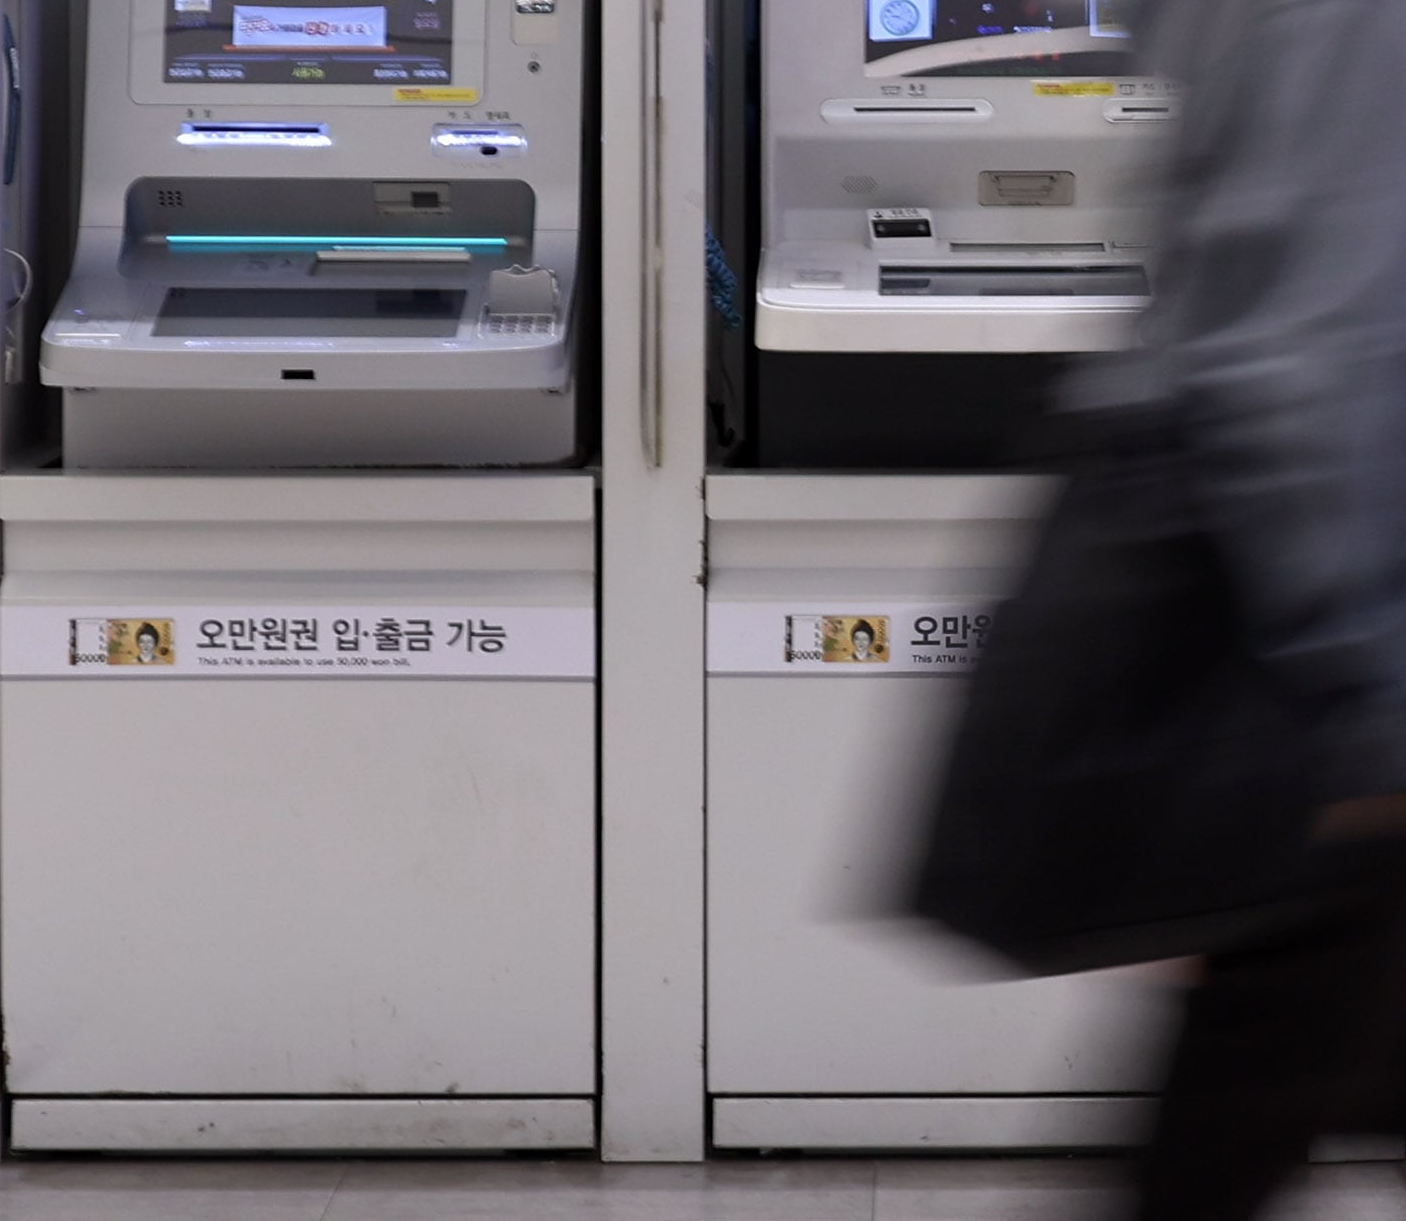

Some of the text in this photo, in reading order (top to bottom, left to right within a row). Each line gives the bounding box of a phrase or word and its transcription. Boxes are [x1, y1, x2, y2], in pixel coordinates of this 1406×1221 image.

[196, 618, 507, 653] 오만원권 입·출금 가능
[198, 657, 218, 667] This
[257, 657, 301, 667] available
[912, 654, 967, 664] This ATM is
